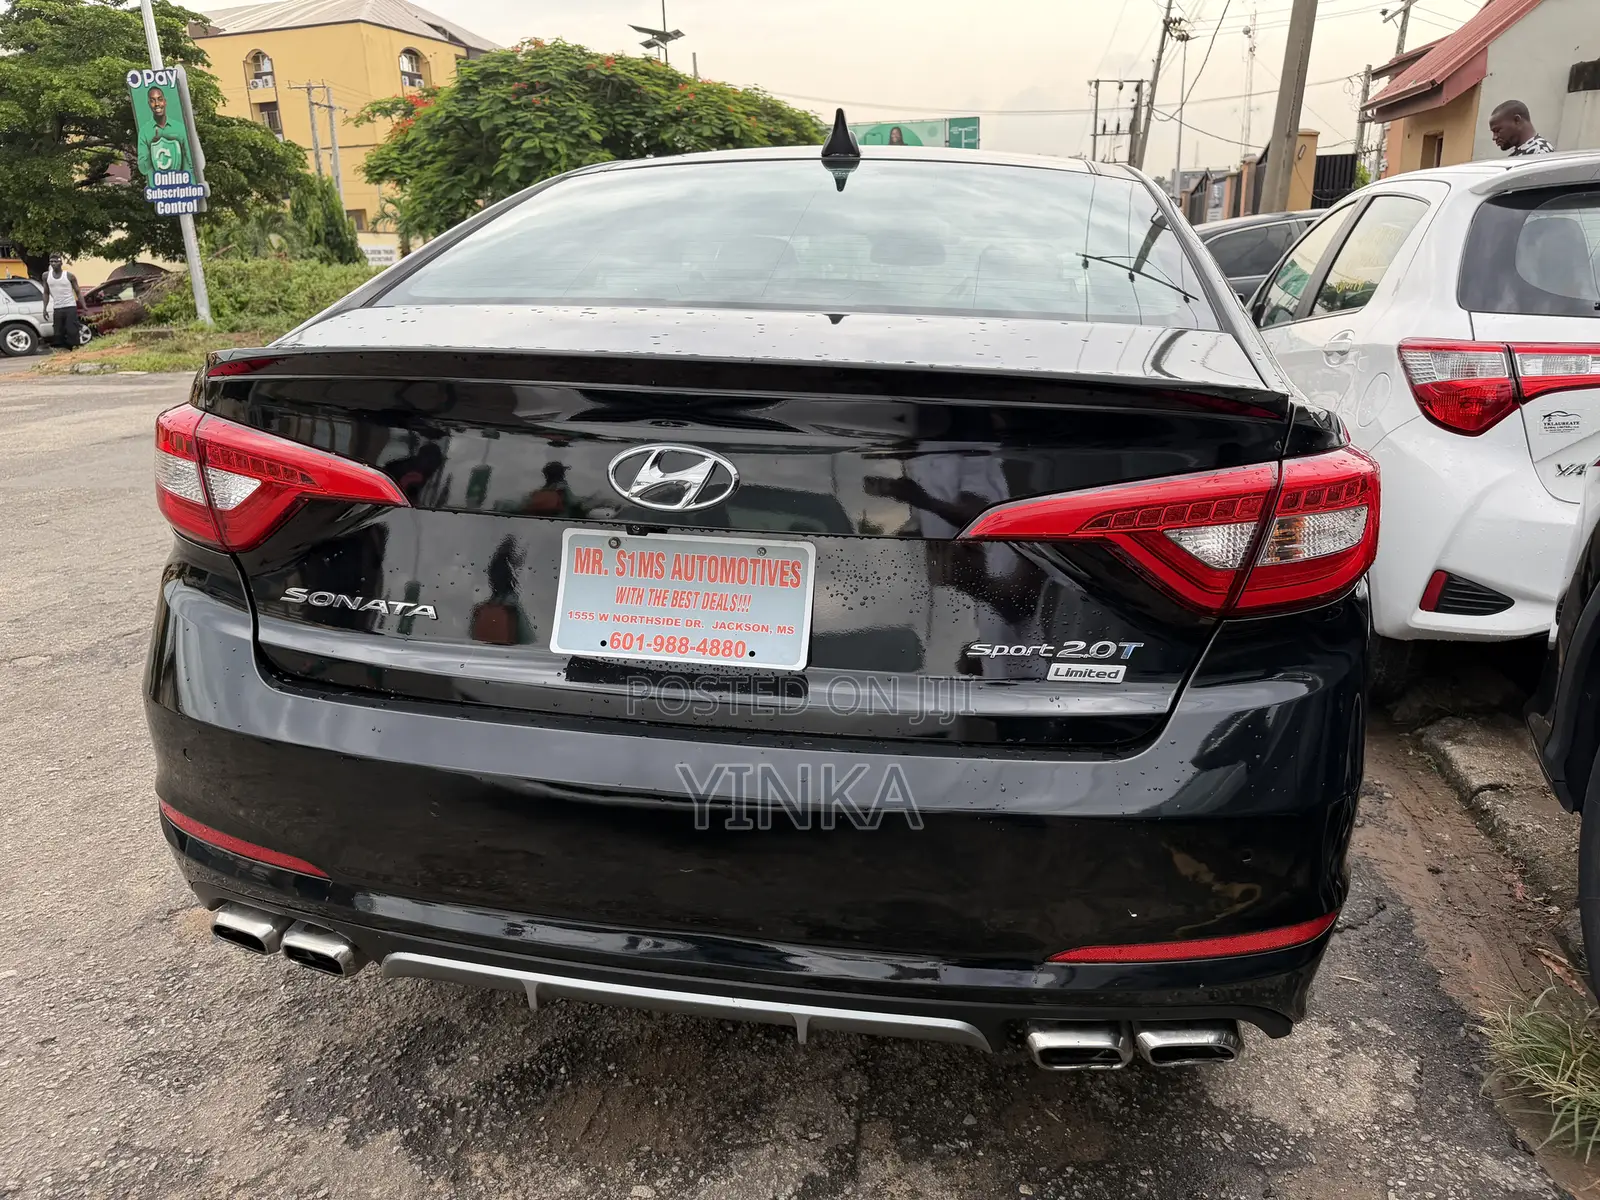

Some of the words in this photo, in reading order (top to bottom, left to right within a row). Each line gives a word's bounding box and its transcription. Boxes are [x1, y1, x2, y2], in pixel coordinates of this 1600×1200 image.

[126, 69, 178, 89] OPay
[154, 172, 190, 186] Online
[146, 186, 204, 200] Subscription
[157, 199, 198, 215] Control
[573, 546, 609, 577] MR.
[615, 549, 666, 580] S1MS
[670, 552, 803, 590] AUTOMOTIVES
[280, 587, 439, 621] SONATA
[615, 585, 645, 606] WITH
[646, 587, 669, 608] THE
[670, 590, 701, 611] BEST
[701, 592, 752, 613] DEALS!!!
[567, 610, 596, 622] 1555
[598, 613, 610, 622] W
[612, 614, 682, 628] NORTHSIDE
[685, 619, 705, 629] DR.
[711, 620, 774, 635] JACKSON,
[776, 625, 795, 635] MS
[609, 631, 747, 659] 601-988-4880
[966, 643, 1055, 658] Sport
[1056, 640, 1145, 660] 2.0T
[1053, 666, 1121, 680] Limited
